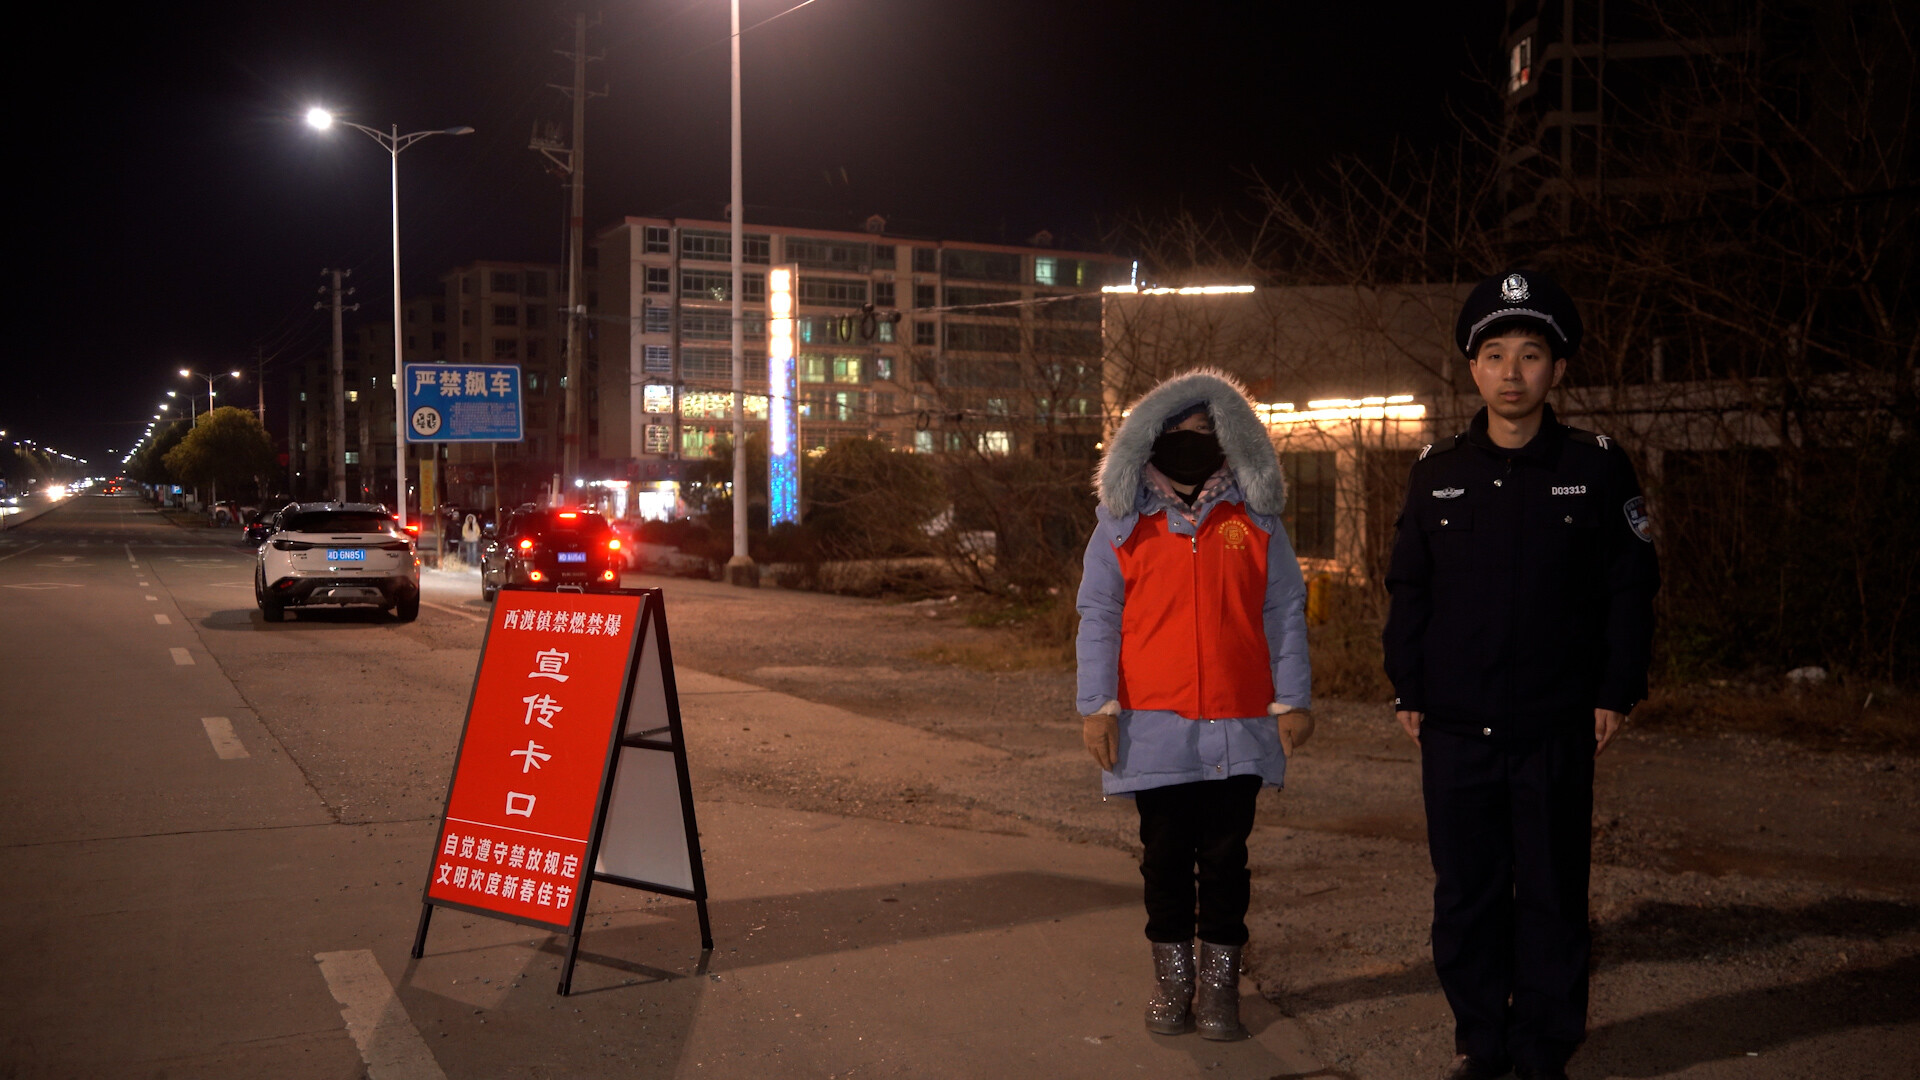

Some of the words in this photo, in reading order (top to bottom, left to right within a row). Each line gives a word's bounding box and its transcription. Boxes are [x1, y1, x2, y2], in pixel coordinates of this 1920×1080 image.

[413, 370, 512, 398] 严禁飙车
[504, 608, 622, 637] 西渡镇禁燃禁爆
[505, 647, 570, 818] 宣传卡口
[443, 832, 579, 879] 自觉遵守禁放规定
[436, 862, 572, 909] 文明欢度新春佳节
